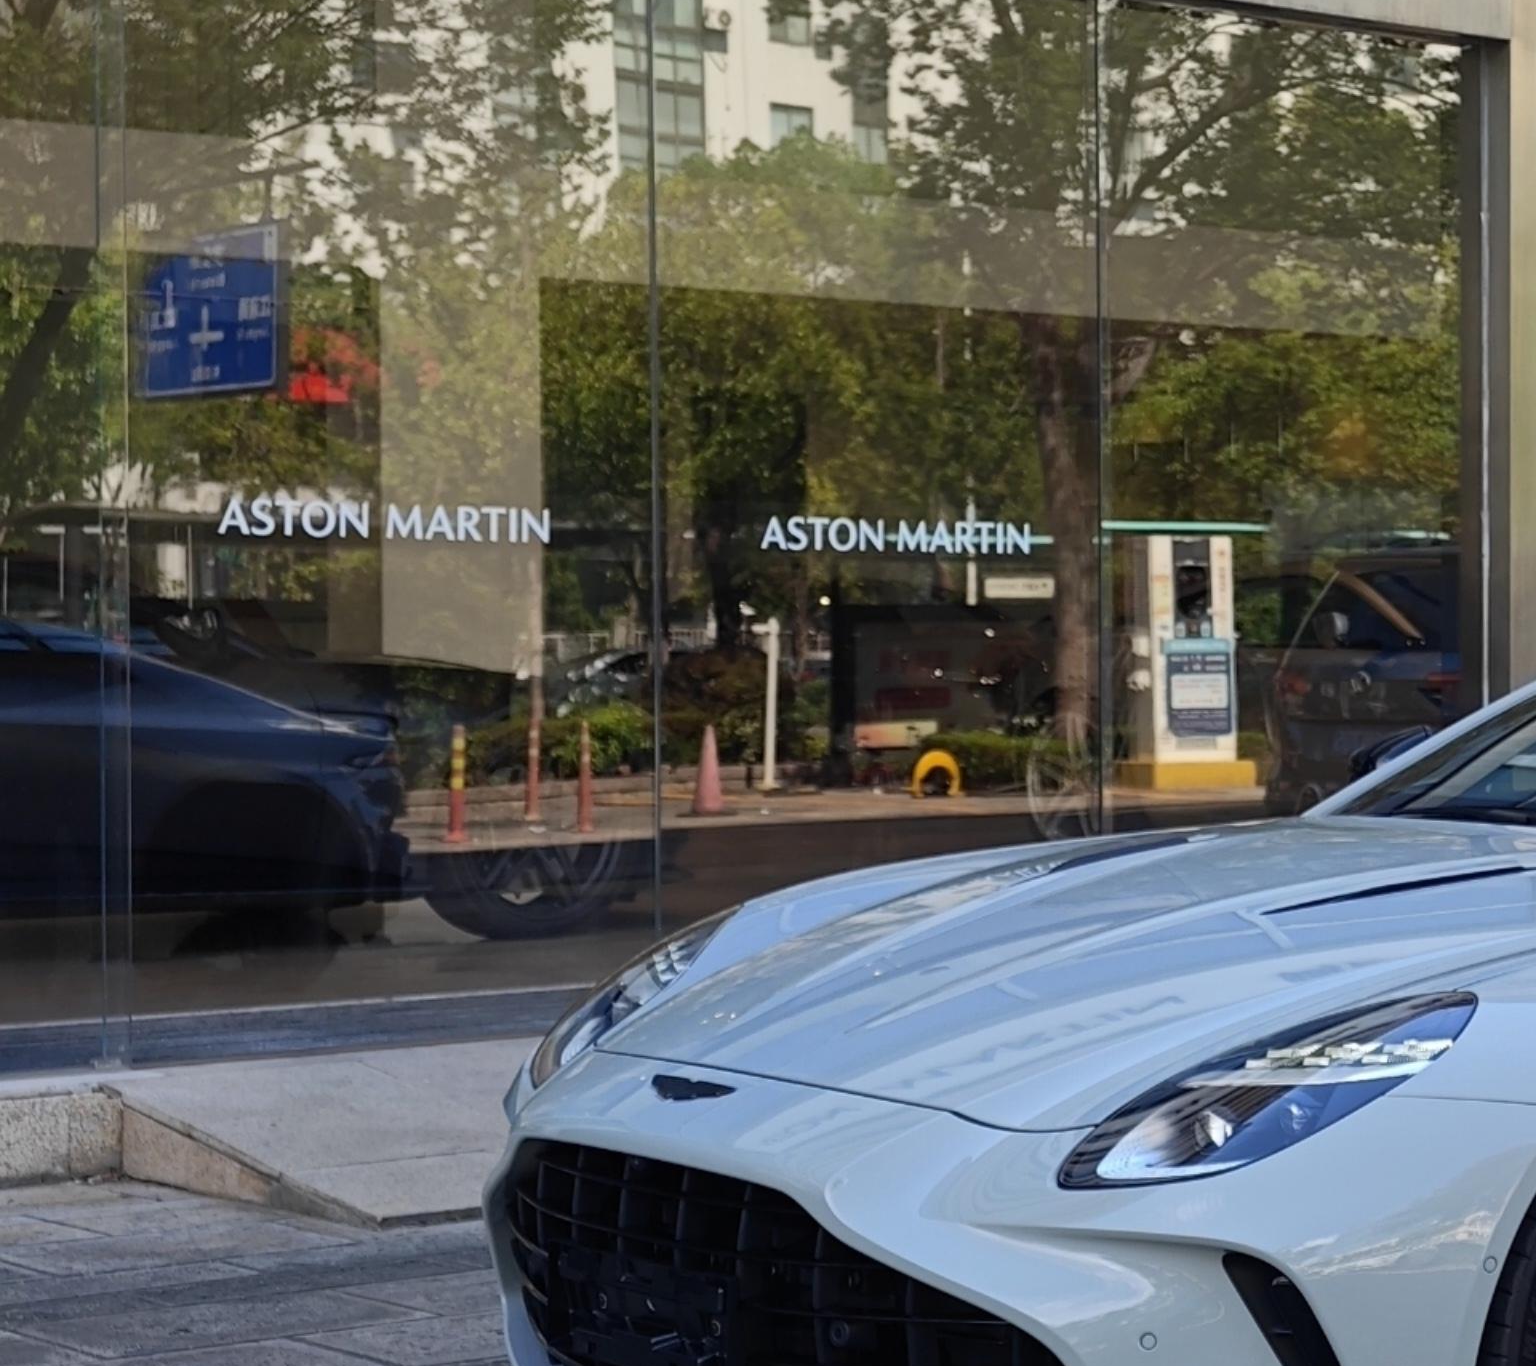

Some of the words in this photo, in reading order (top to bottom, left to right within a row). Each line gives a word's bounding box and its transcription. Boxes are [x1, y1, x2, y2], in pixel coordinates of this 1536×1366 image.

[218, 497, 369, 538] ASTON
[386, 503, 550, 544] MARTIN
[760, 515, 885, 552] ASTON
[897, 519, 1030, 555] MARTIN
